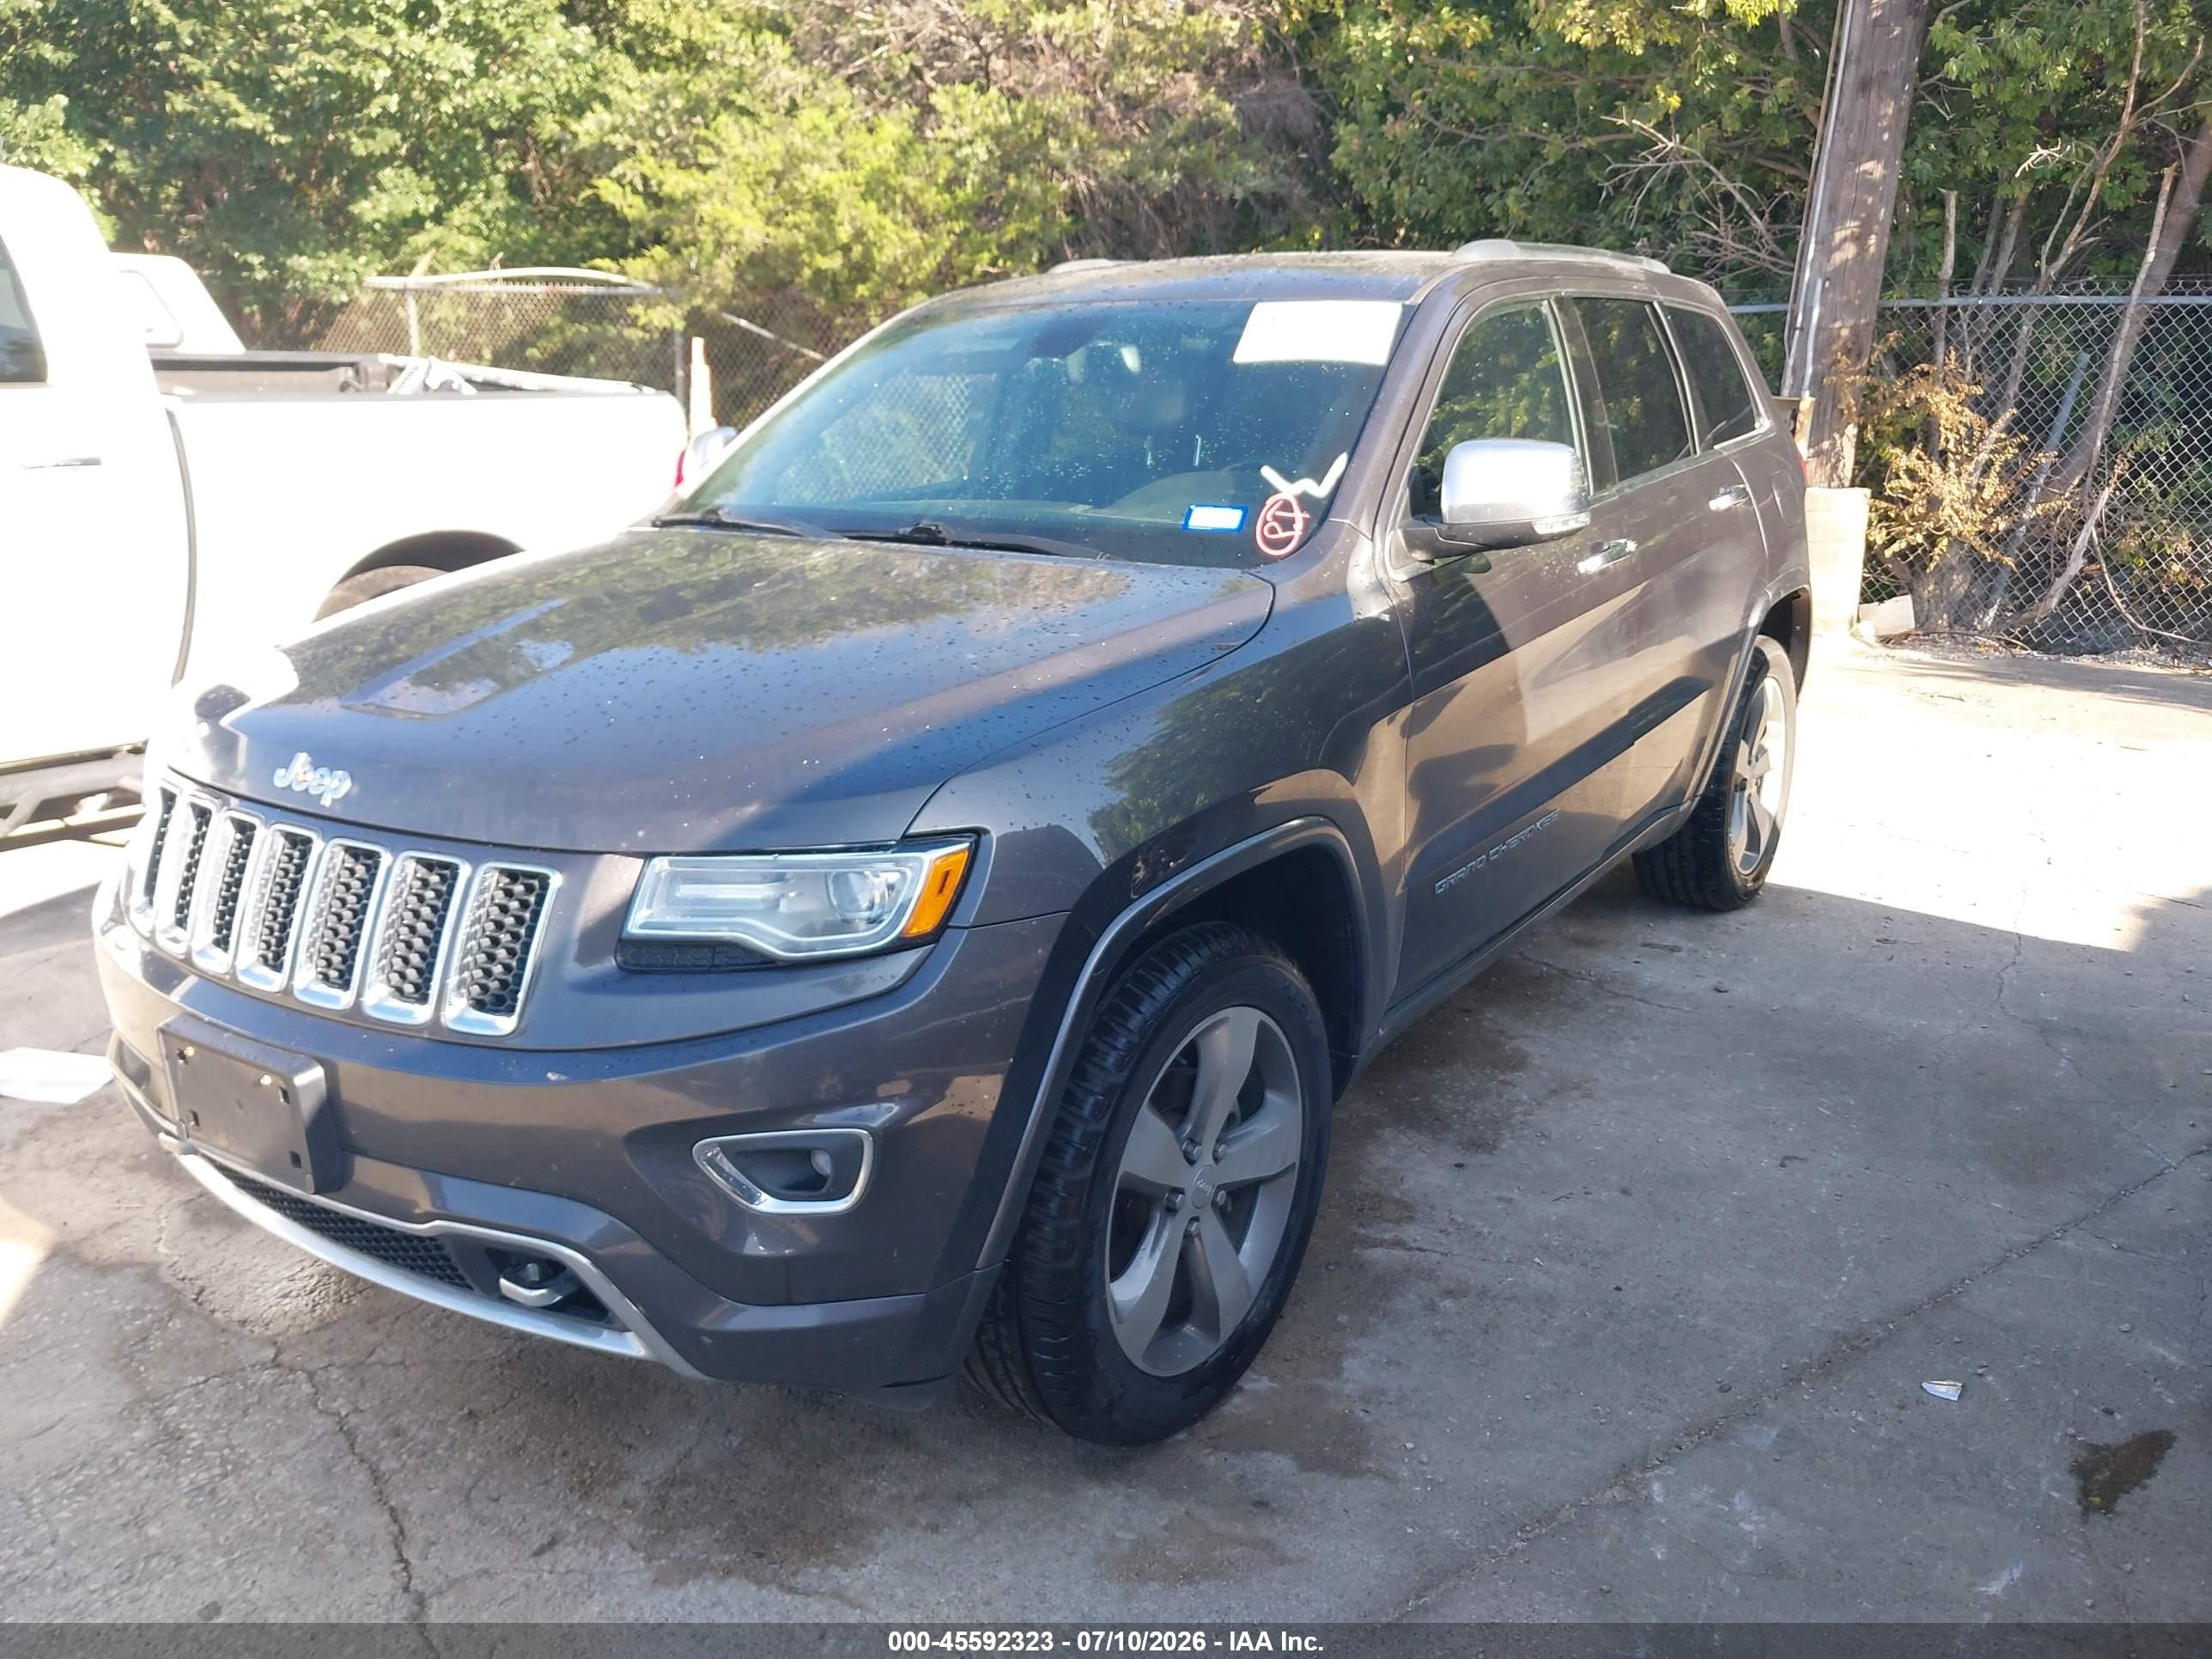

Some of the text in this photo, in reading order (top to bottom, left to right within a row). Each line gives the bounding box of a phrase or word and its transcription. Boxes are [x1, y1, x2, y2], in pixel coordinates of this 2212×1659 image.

[273, 751, 352, 807] Jeep
[1435, 808, 1560, 894] GRAND CHEROKEE
